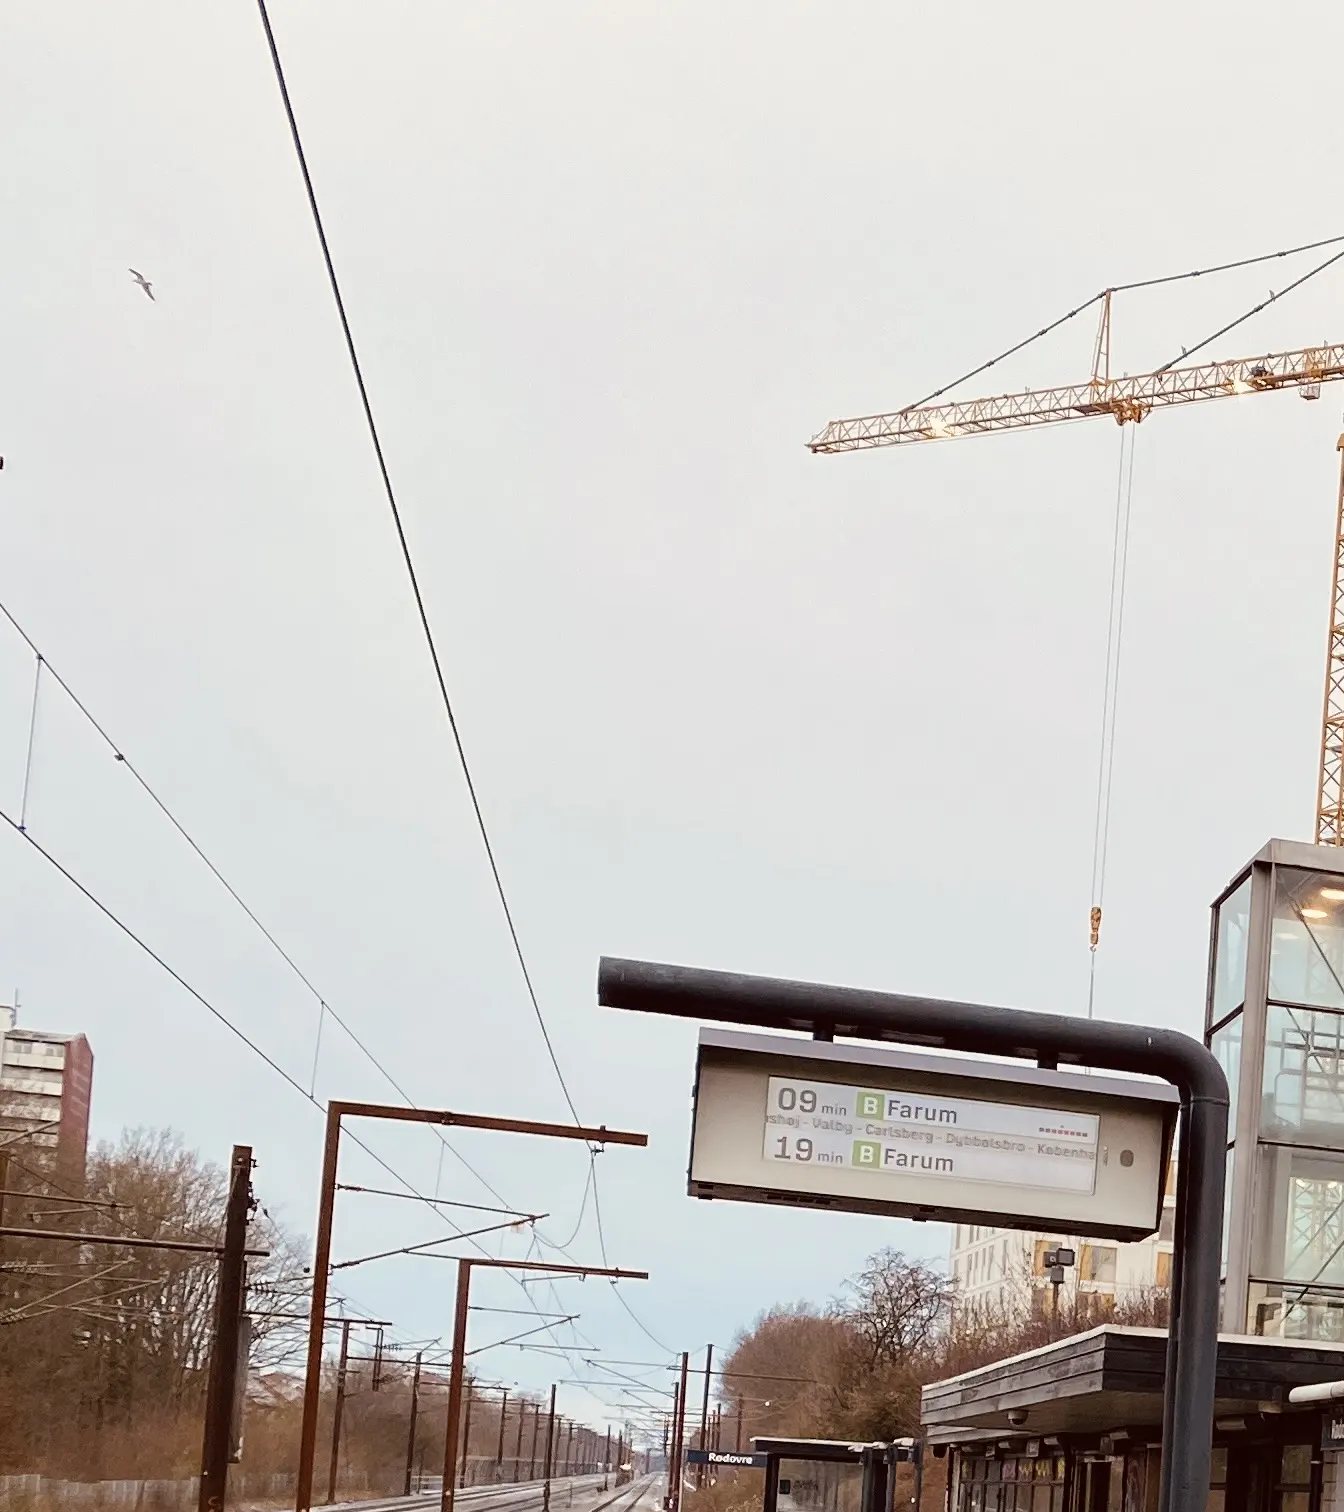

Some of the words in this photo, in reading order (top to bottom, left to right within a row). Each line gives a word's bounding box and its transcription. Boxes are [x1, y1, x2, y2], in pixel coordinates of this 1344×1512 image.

[778, 1087, 817, 1113] 09
[821, 1104, 847, 1117] min
[863, 1096, 878, 1115] B
[887, 1099, 957, 1124] Farum
[812, 1117, 854, 1135] Valby
[865, 1123, 934, 1145] Carlsberg
[774, 1136, 814, 1162] 19
[817, 1151, 843, 1165] min
[859, 1145, 874, 1163] B
[884, 1148, 954, 1173] Farum
[708, 1452, 744, 1465] Rødovre
